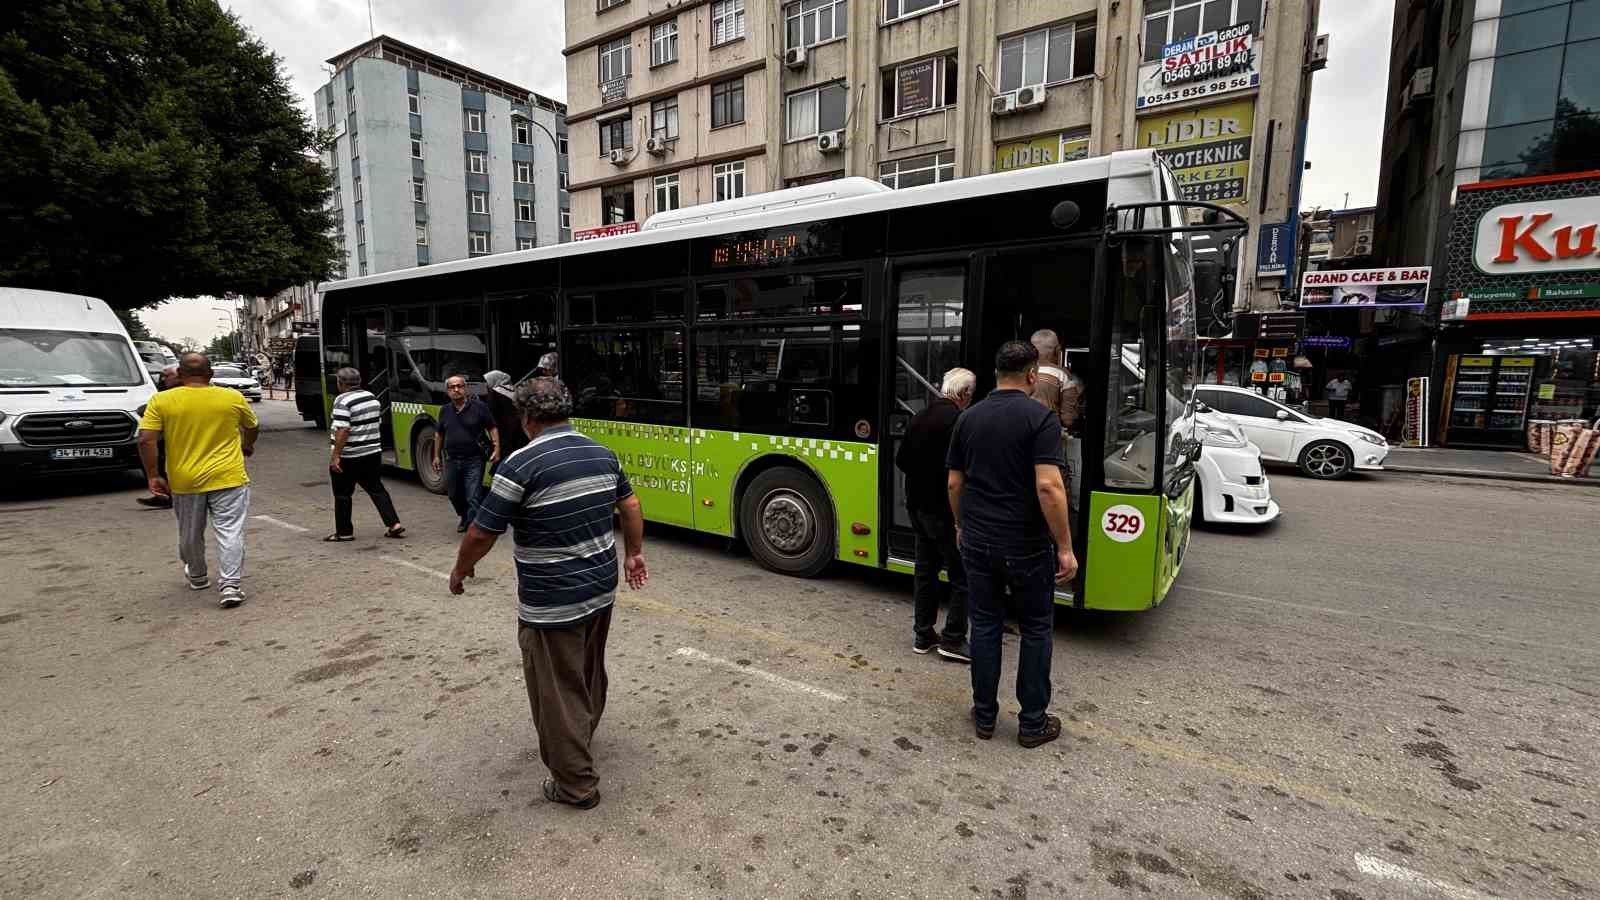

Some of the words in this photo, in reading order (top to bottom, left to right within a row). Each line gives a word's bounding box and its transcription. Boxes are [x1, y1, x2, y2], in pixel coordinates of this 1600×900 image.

[1164, 41, 1194, 57] DERAN
[1219, 24, 1250, 40] GROUP
[1165, 37, 1248, 70] SATILIK
[1164, 66, 1191, 83] 0546
[1193, 61, 1213, 76] 201
[1217, 56, 1231, 69] 89
[1235, 51, 1248, 64] 40
[1147, 91, 1179, 104] 0543
[1182, 86, 1206, 97] 836
[1210, 81, 1226, 92] 98
[1230, 78, 1247, 88] 56
[1160, 142, 1244, 169] KOTEKNİK
[1491, 212, 1600, 264] Ku
[1305, 273, 1348, 284] GRAND
[1351, 271, 1384, 283] CAFE
[1387, 271, 1397, 282] &
[1400, 270, 1429, 281] BAR
[1545, 288, 1584, 297] Baharat
[1105, 512, 1140, 534] 329
